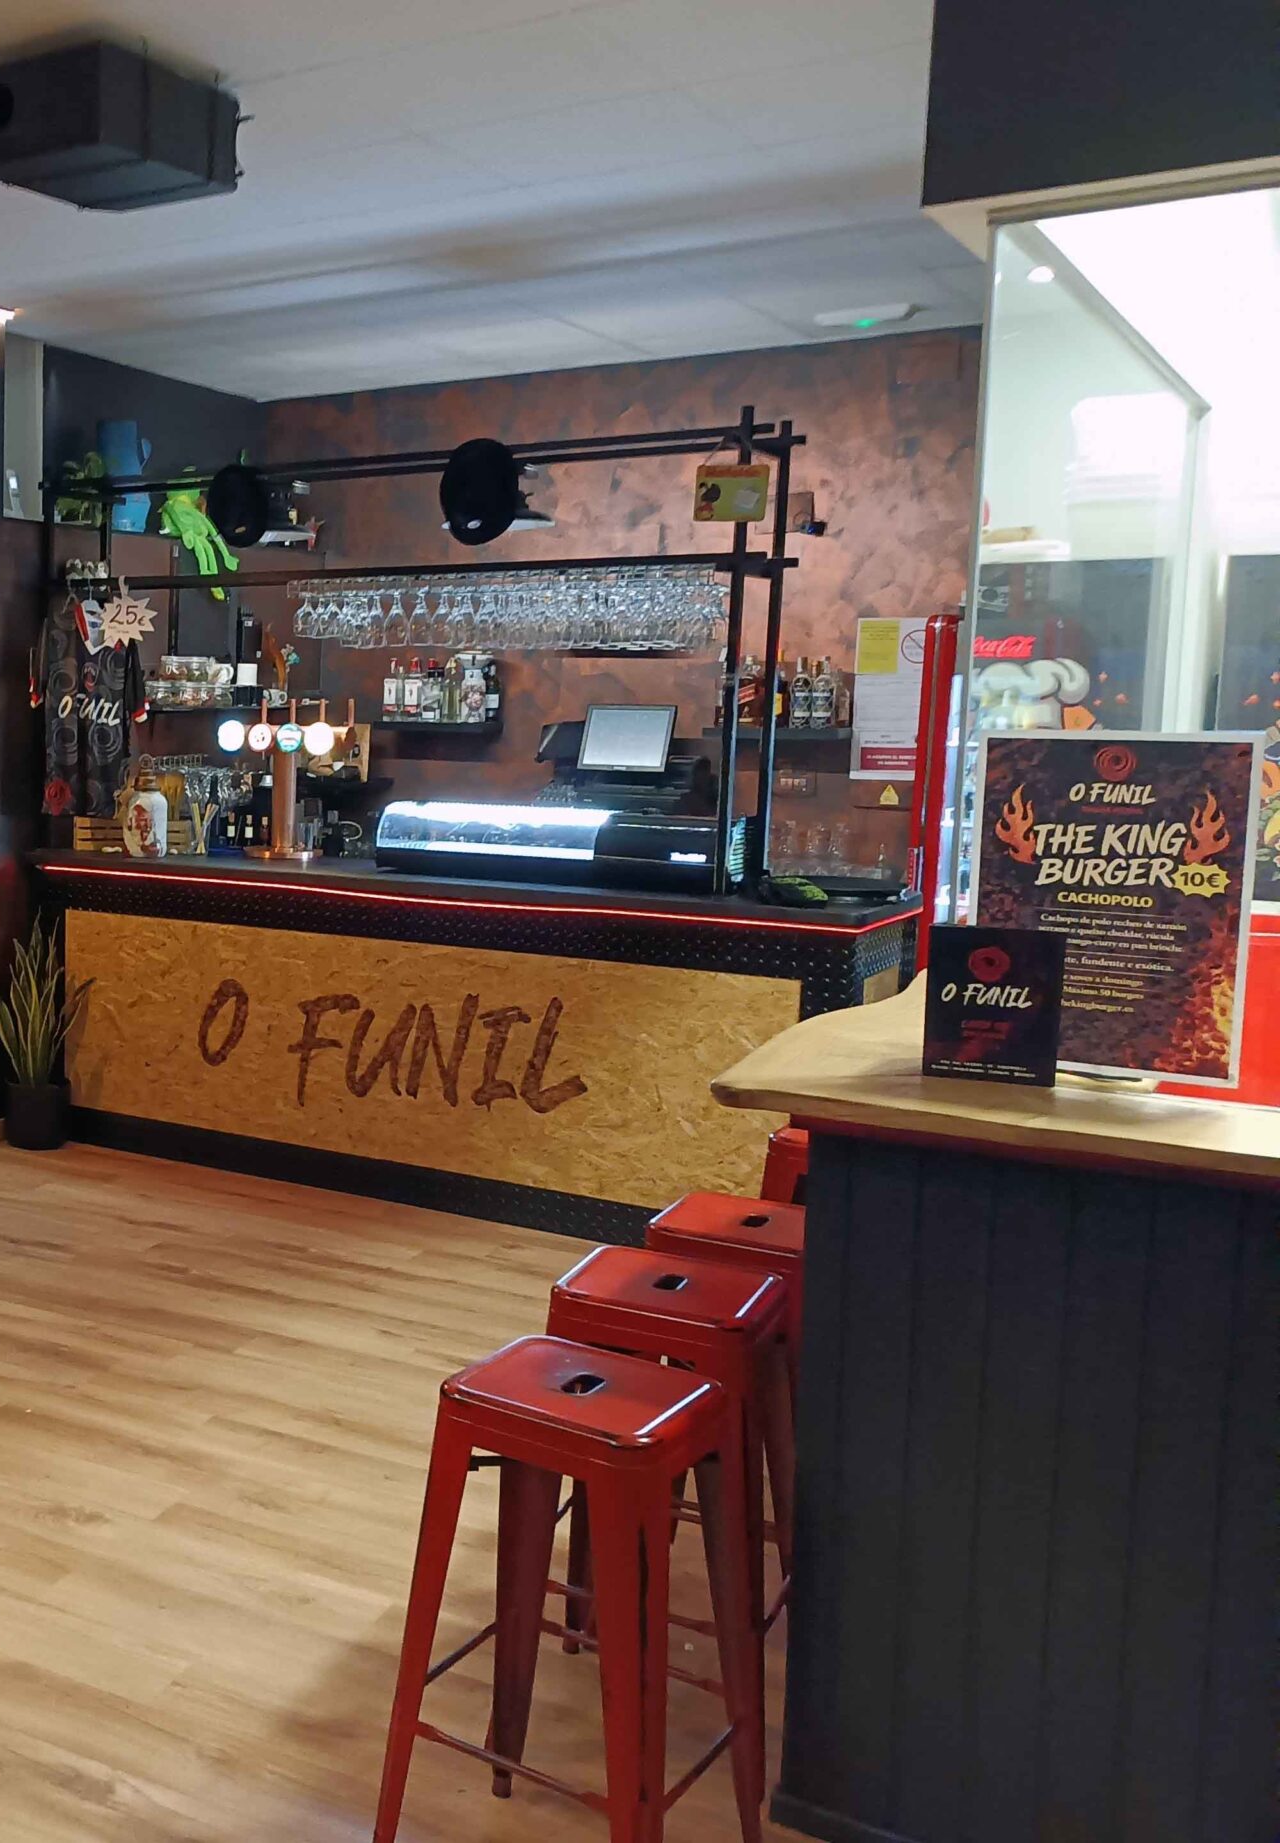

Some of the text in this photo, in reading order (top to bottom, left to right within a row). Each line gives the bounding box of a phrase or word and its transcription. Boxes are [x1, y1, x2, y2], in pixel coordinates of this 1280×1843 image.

[109, 604, 146, 626] 25€
[58, 695, 73, 719] O
[1069, 782, 1157, 805] O FUNIL
[1033, 820, 1187, 856] THE KING
[1034, 857, 1175, 889] BURGER
[1180, 872, 1221, 888] 10€
[1057, 891, 1154, 909] CACHOPOLO
[1040, 913, 1080, 925] Cachopo
[1080, 915, 1091, 925] de
[1092, 917, 1112, 927] polo
[1143, 920, 1155, 929] de
[1081, 956, 1125, 968] fundente
[940, 982, 1033, 1009] O FUNIL
[198, 979, 588, 1114] O FUNIL
